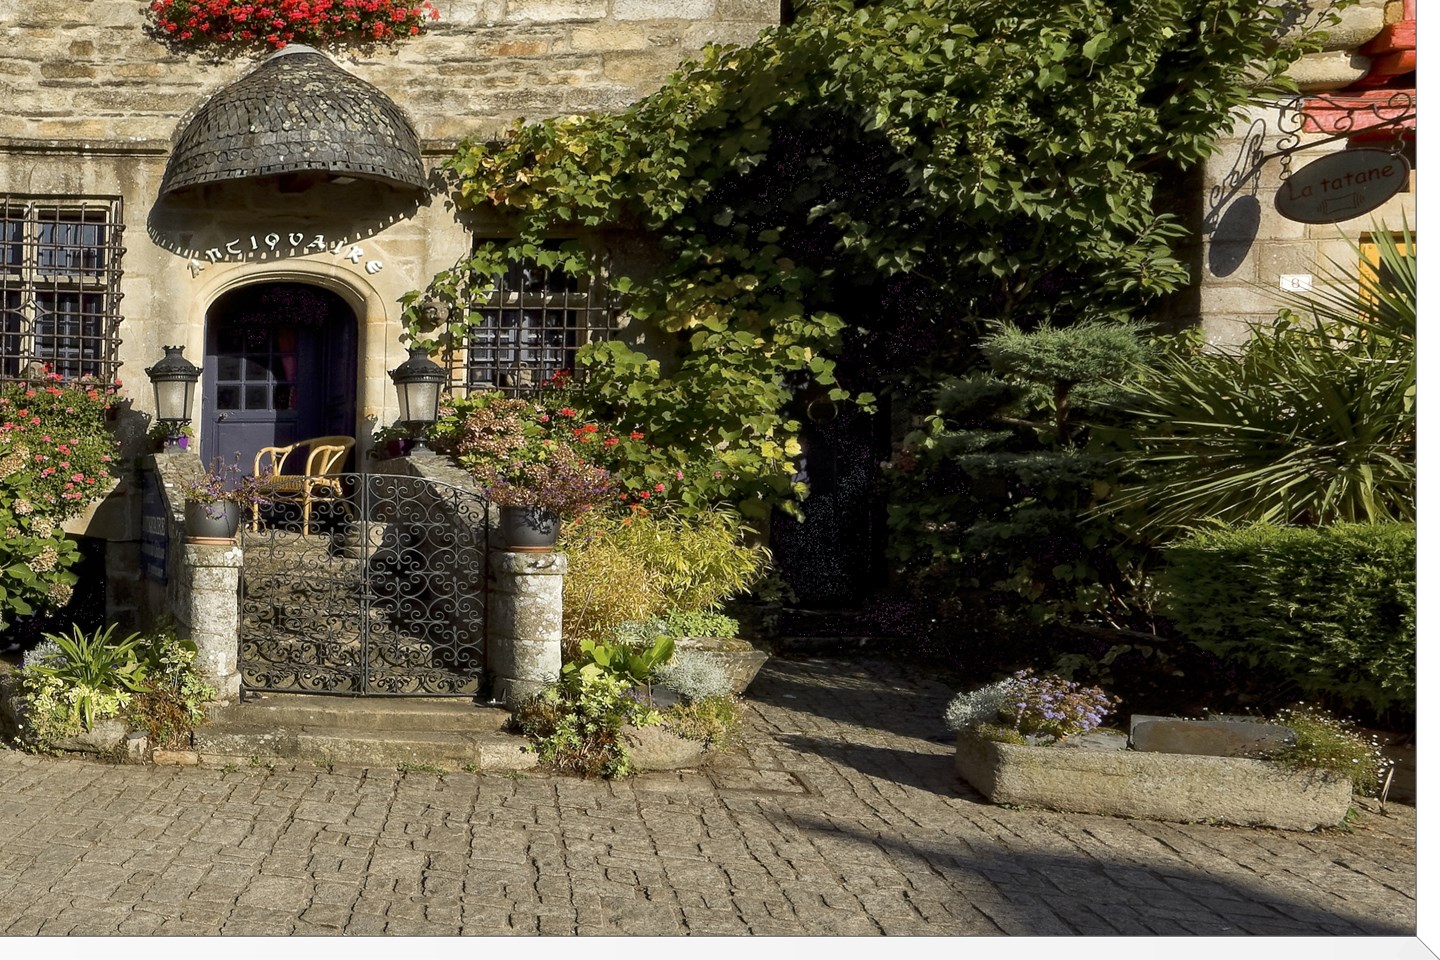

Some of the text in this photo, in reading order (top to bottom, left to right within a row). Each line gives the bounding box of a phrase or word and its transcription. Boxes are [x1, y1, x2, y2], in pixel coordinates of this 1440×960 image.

[1288, 164, 1394, 201] La tatane
[1291, 277, 1300, 288] 8
